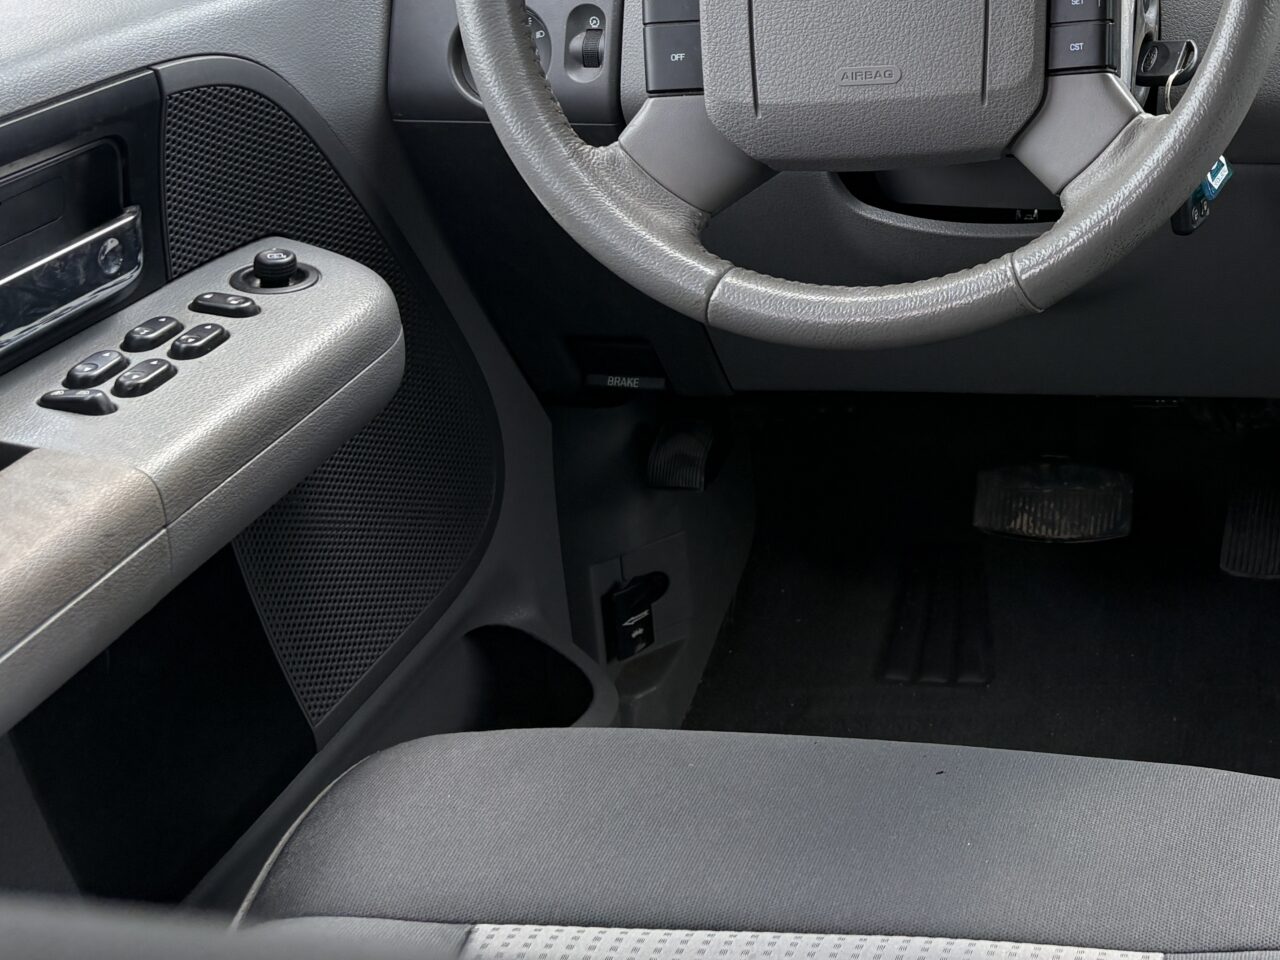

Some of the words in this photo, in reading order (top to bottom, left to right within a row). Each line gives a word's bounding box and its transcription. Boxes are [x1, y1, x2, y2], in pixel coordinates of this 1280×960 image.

[1069, 42, 1084, 52] CST
[670, 53, 686, 62] OFF
[841, 69, 894, 81] AIRBAG
[607, 376, 639, 387] BRAKE
